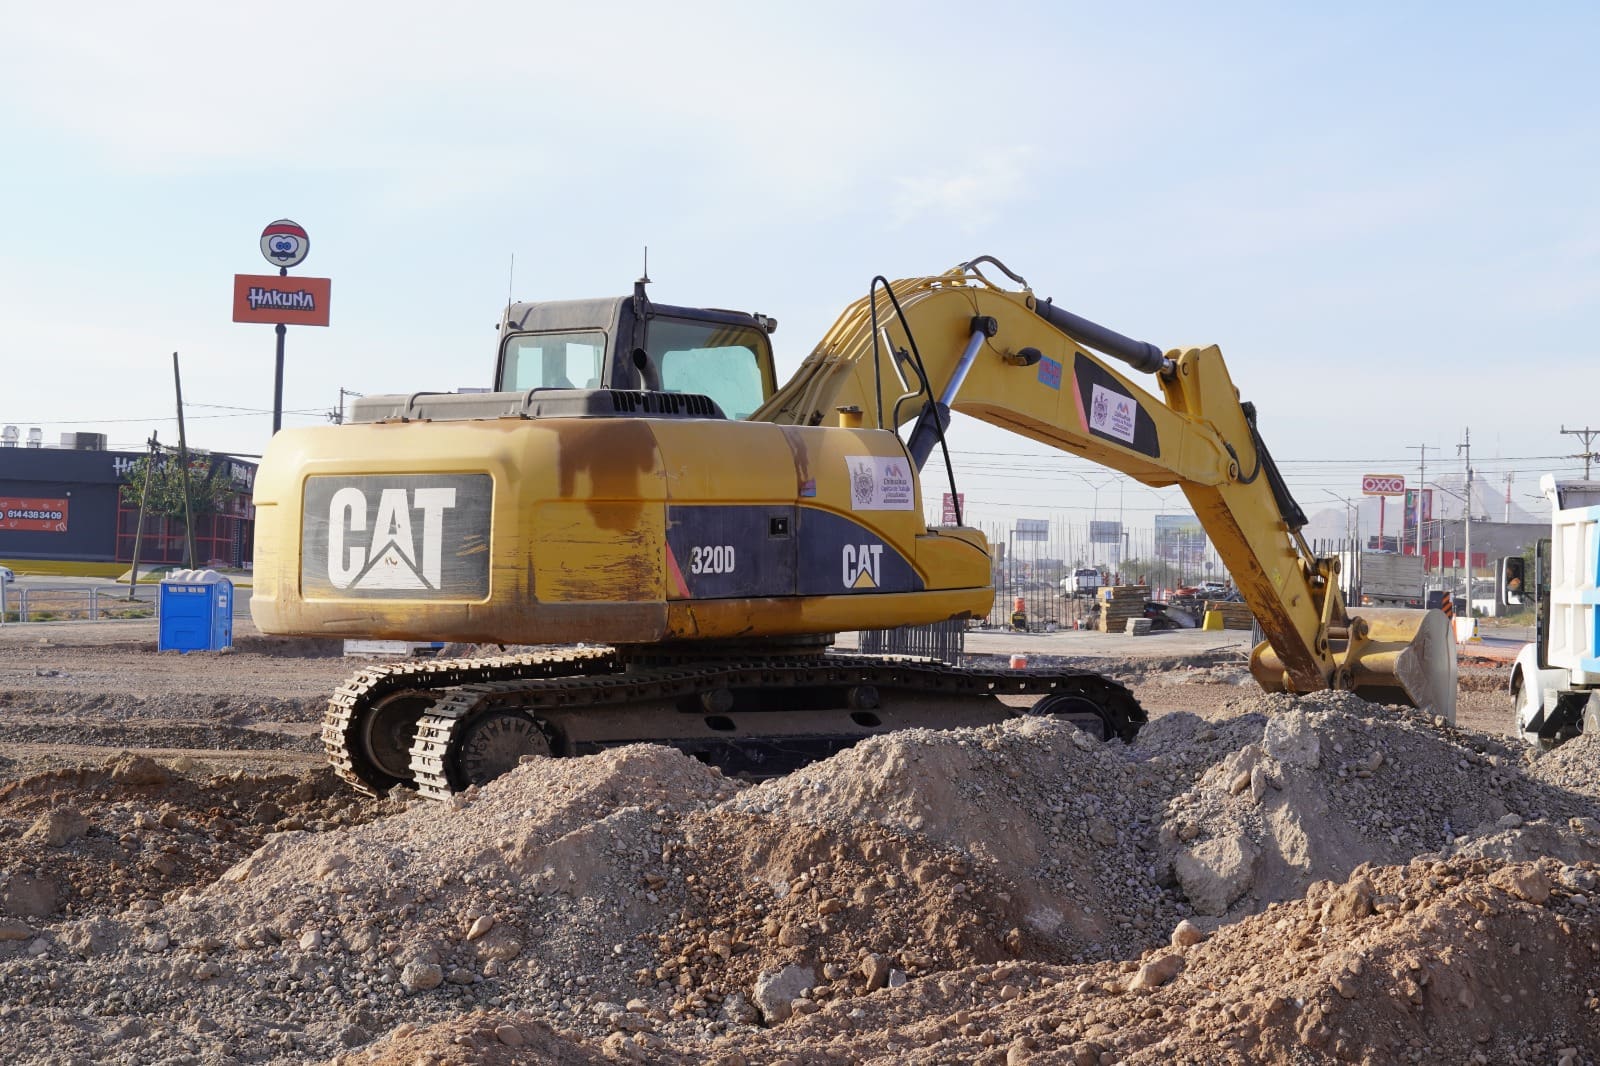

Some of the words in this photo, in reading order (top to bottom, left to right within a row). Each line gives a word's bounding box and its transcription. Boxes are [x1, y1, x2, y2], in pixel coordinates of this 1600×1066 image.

[248, 288, 314, 309] HAKUNA
[1364, 478, 1403, 492] OXXO
[8, 510, 22, 518] 614
[328, 487, 457, 590] CAT
[691, 545, 735, 575] 320D
[842, 544, 883, 589] CAT
